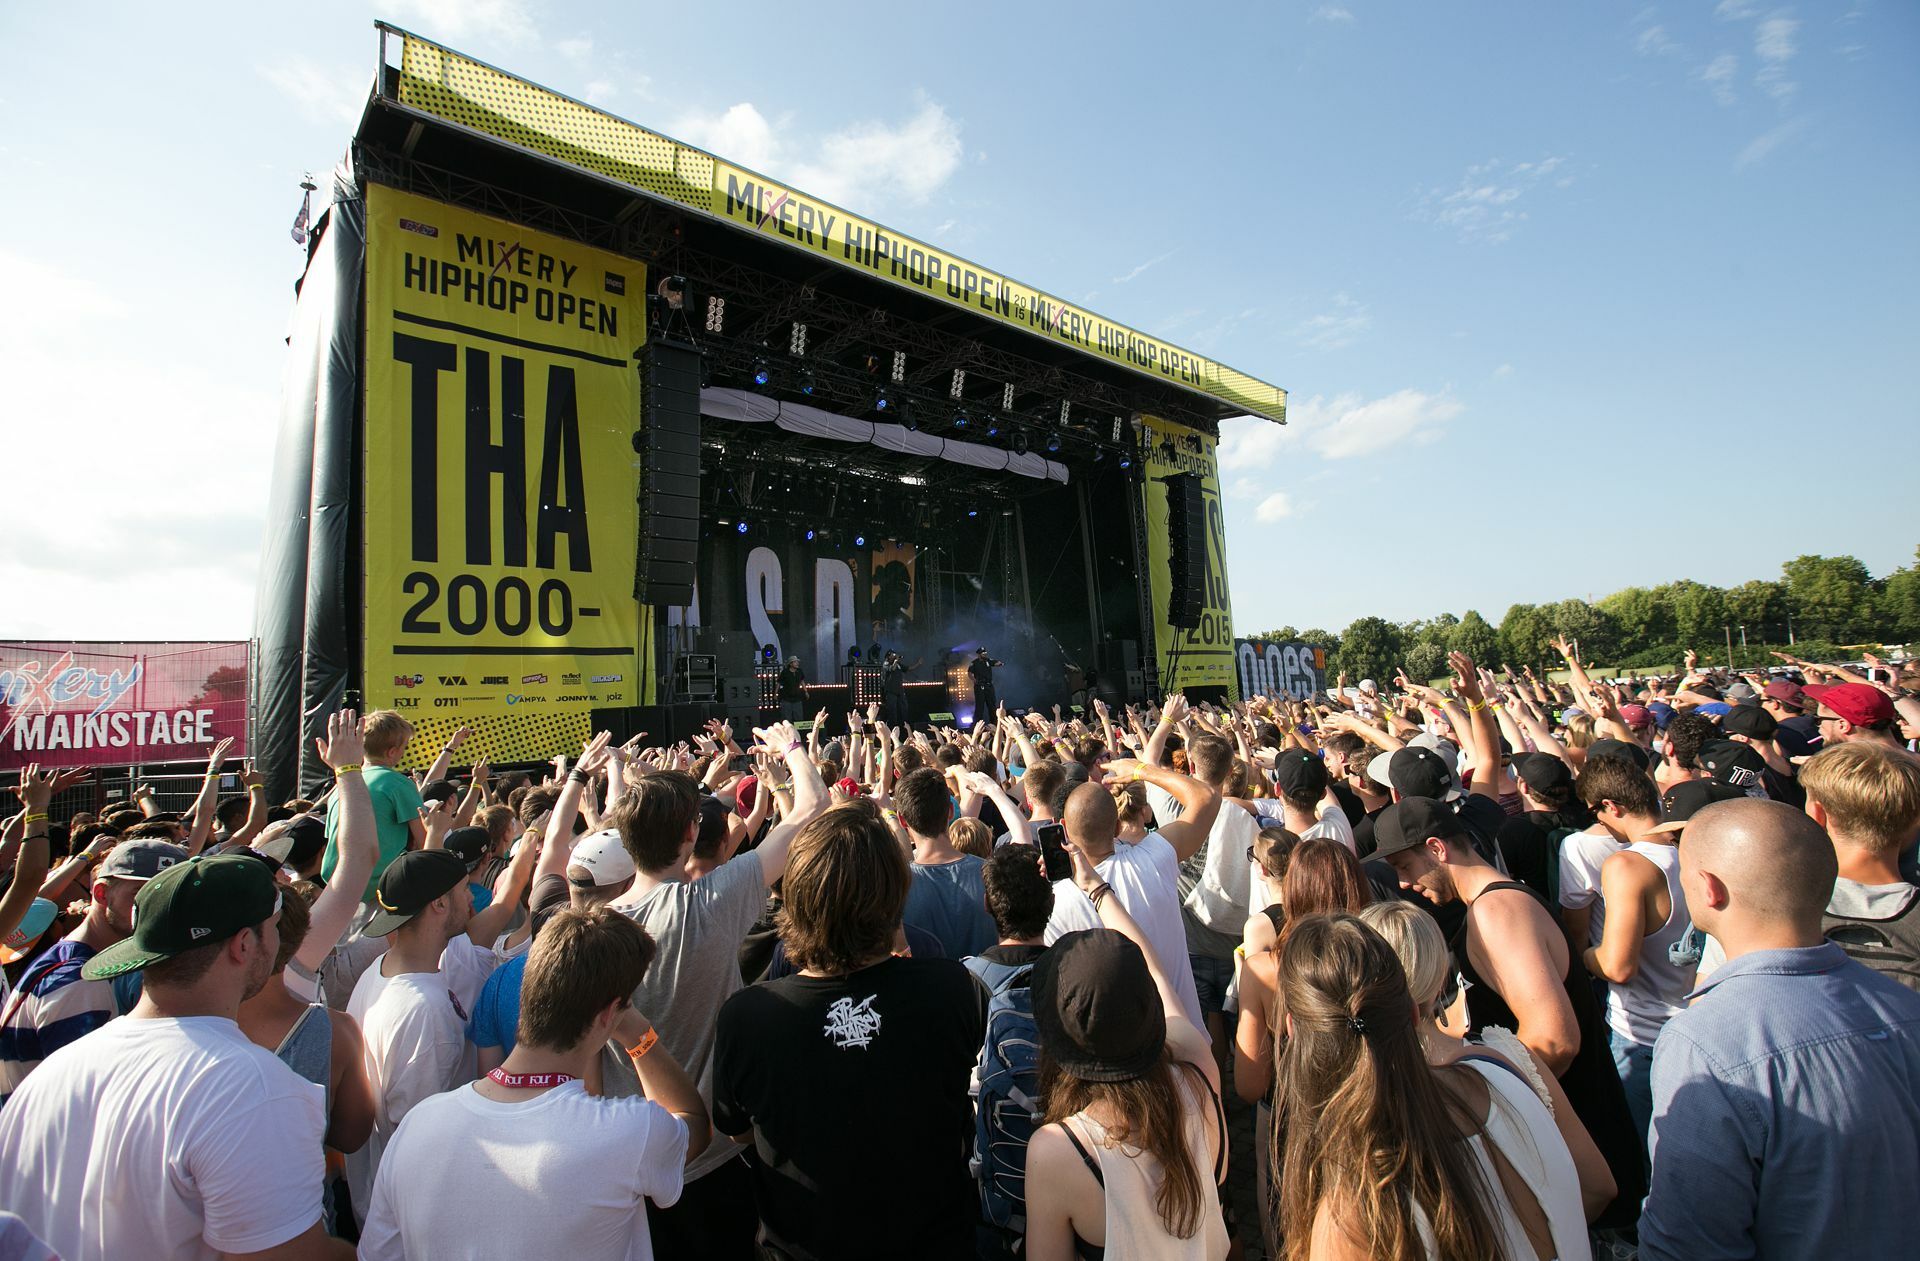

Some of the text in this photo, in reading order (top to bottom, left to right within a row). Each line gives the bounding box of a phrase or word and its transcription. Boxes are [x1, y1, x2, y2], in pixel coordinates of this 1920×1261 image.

[456, 233, 578, 288] MIXERY
[726, 174, 1010, 318] MIXERY HIPHOP OPEN
[404, 252, 617, 337] HIPHOP OPEN
[1030, 295, 1200, 385] MIXERY HIPHOP OPEN
[393, 331, 592, 573] THA
[434, 697, 459, 707] 0711
[480, 676, 509, 685] JUICE
[14, 709, 214, 751] MAINSTAGE
